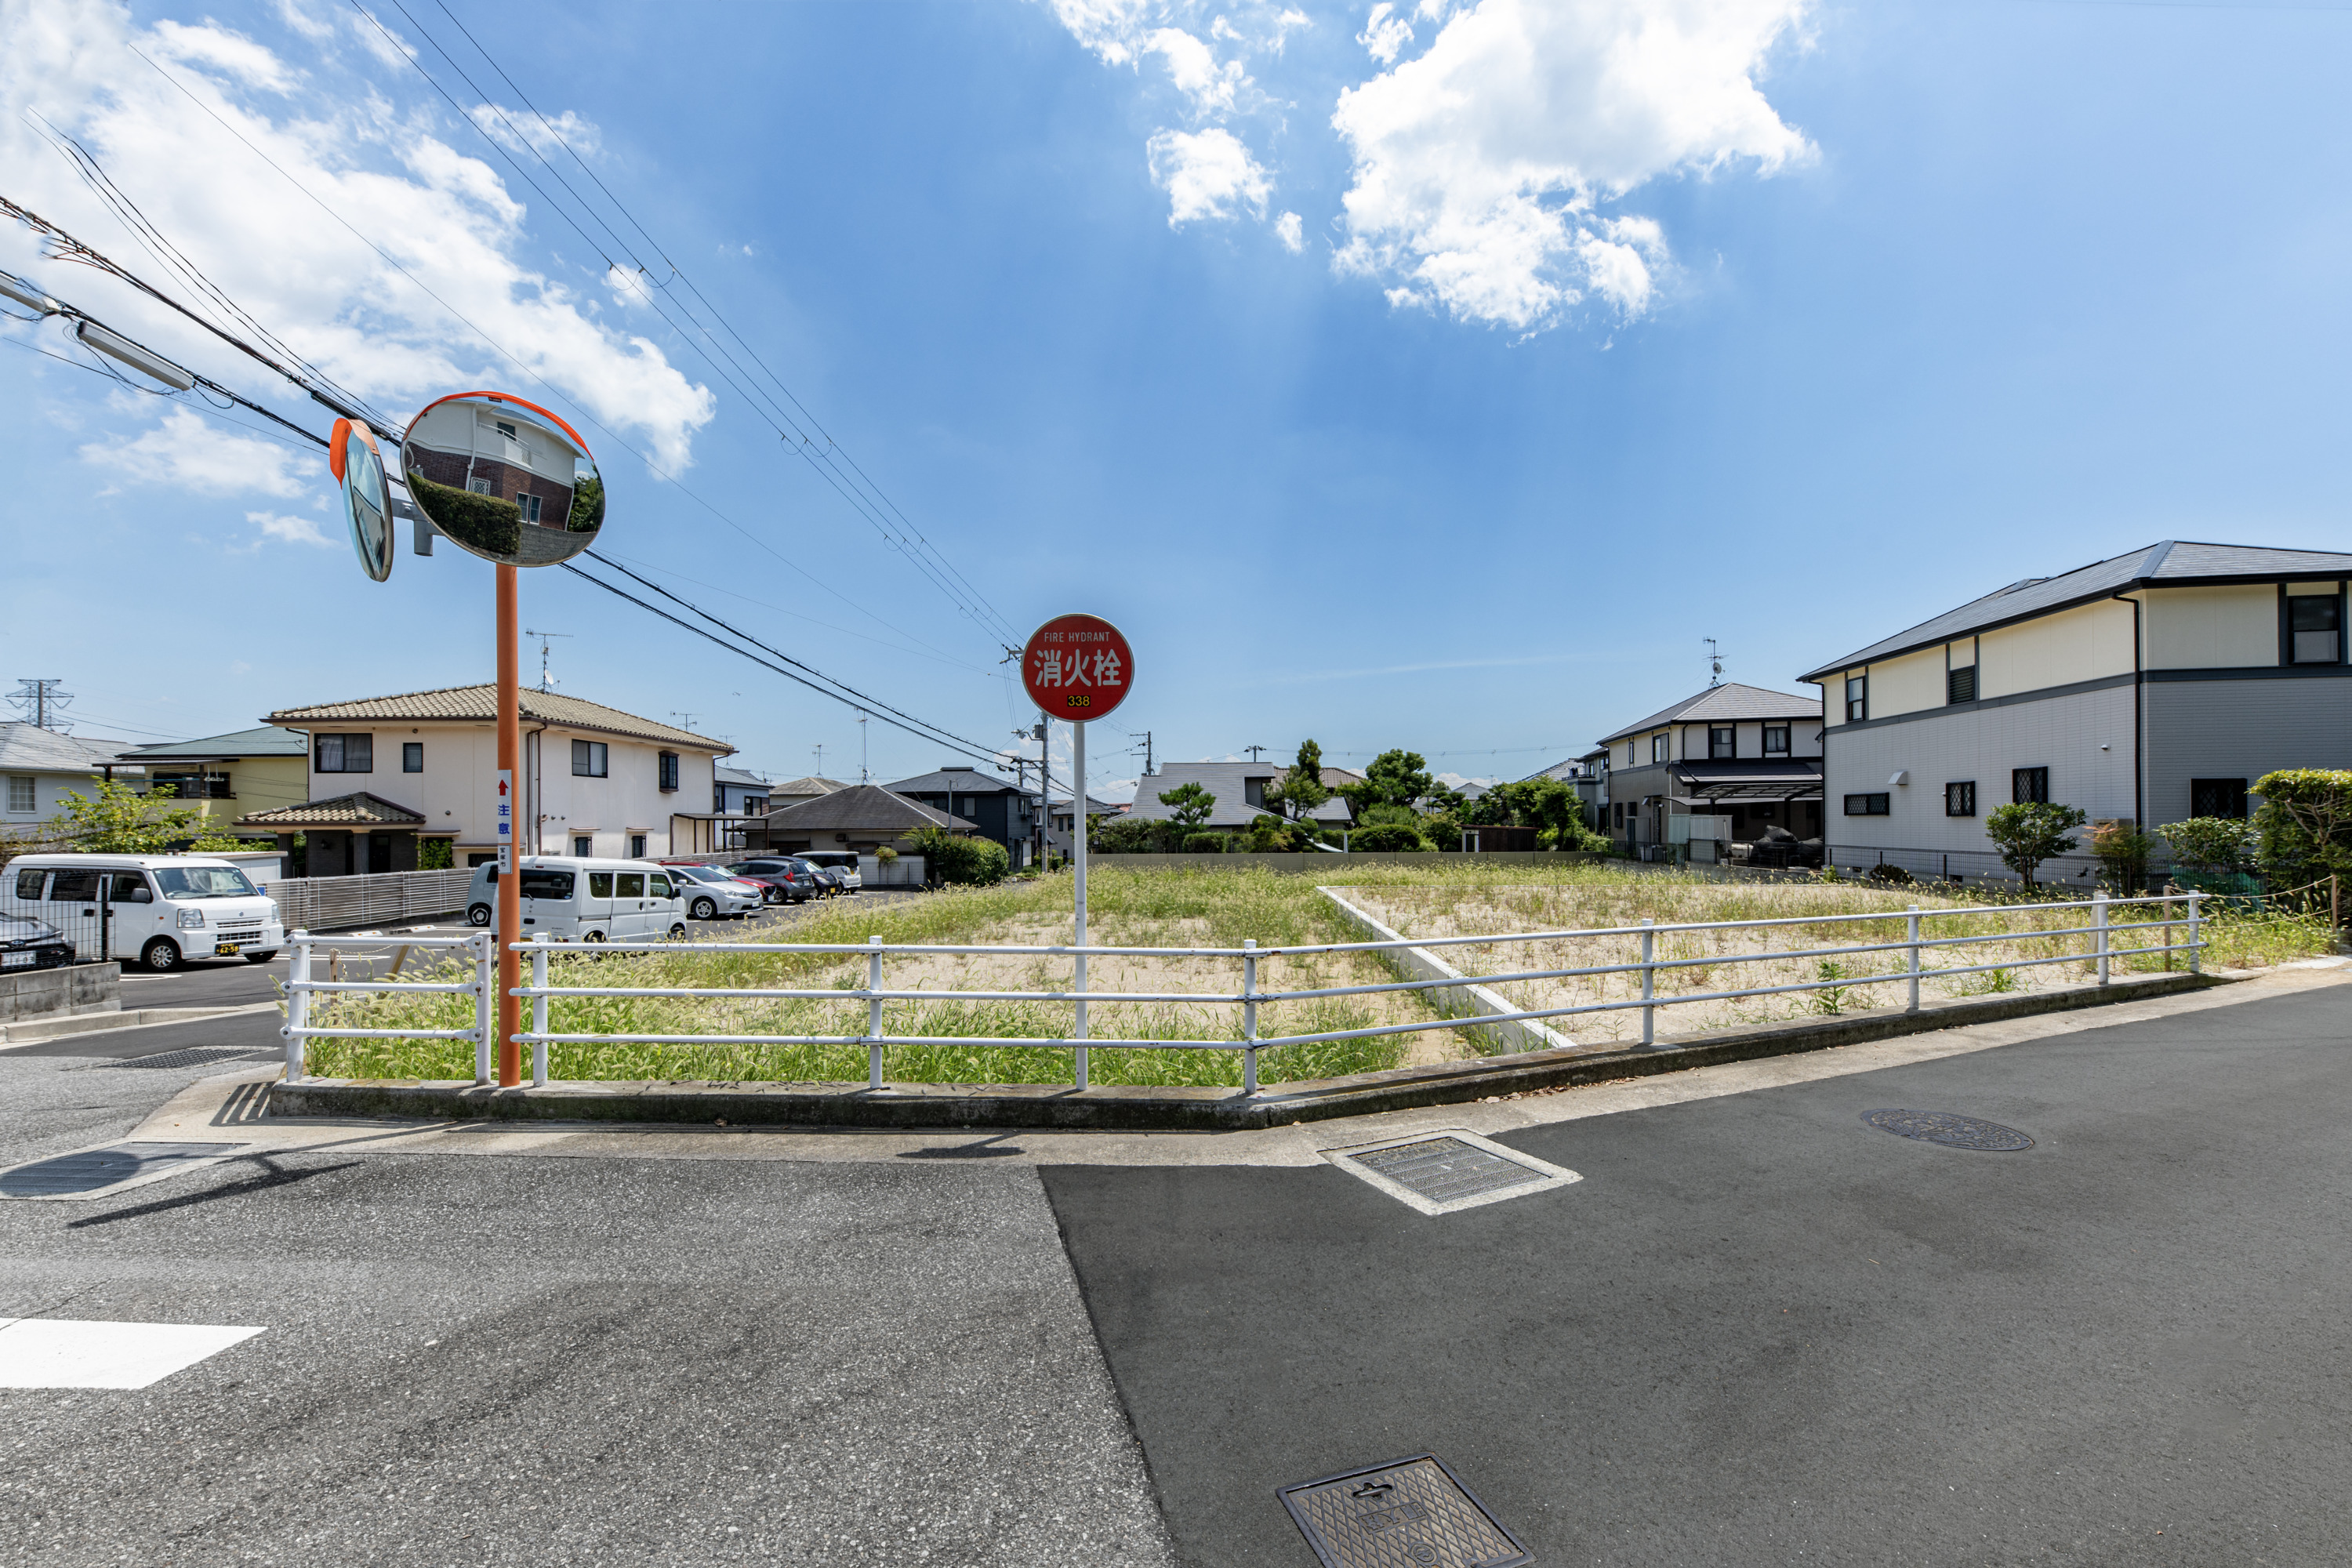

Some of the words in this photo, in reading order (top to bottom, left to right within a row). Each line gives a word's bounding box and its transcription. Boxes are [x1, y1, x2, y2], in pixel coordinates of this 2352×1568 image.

[1044, 632, 1064, 642] FIRE
[1069, 632, 1109, 642] HYDRANT
[1033, 648, 1122, 688] 消火栓
[1067, 695, 1090, 706] 338
[498, 804, 510, 835] 注意
